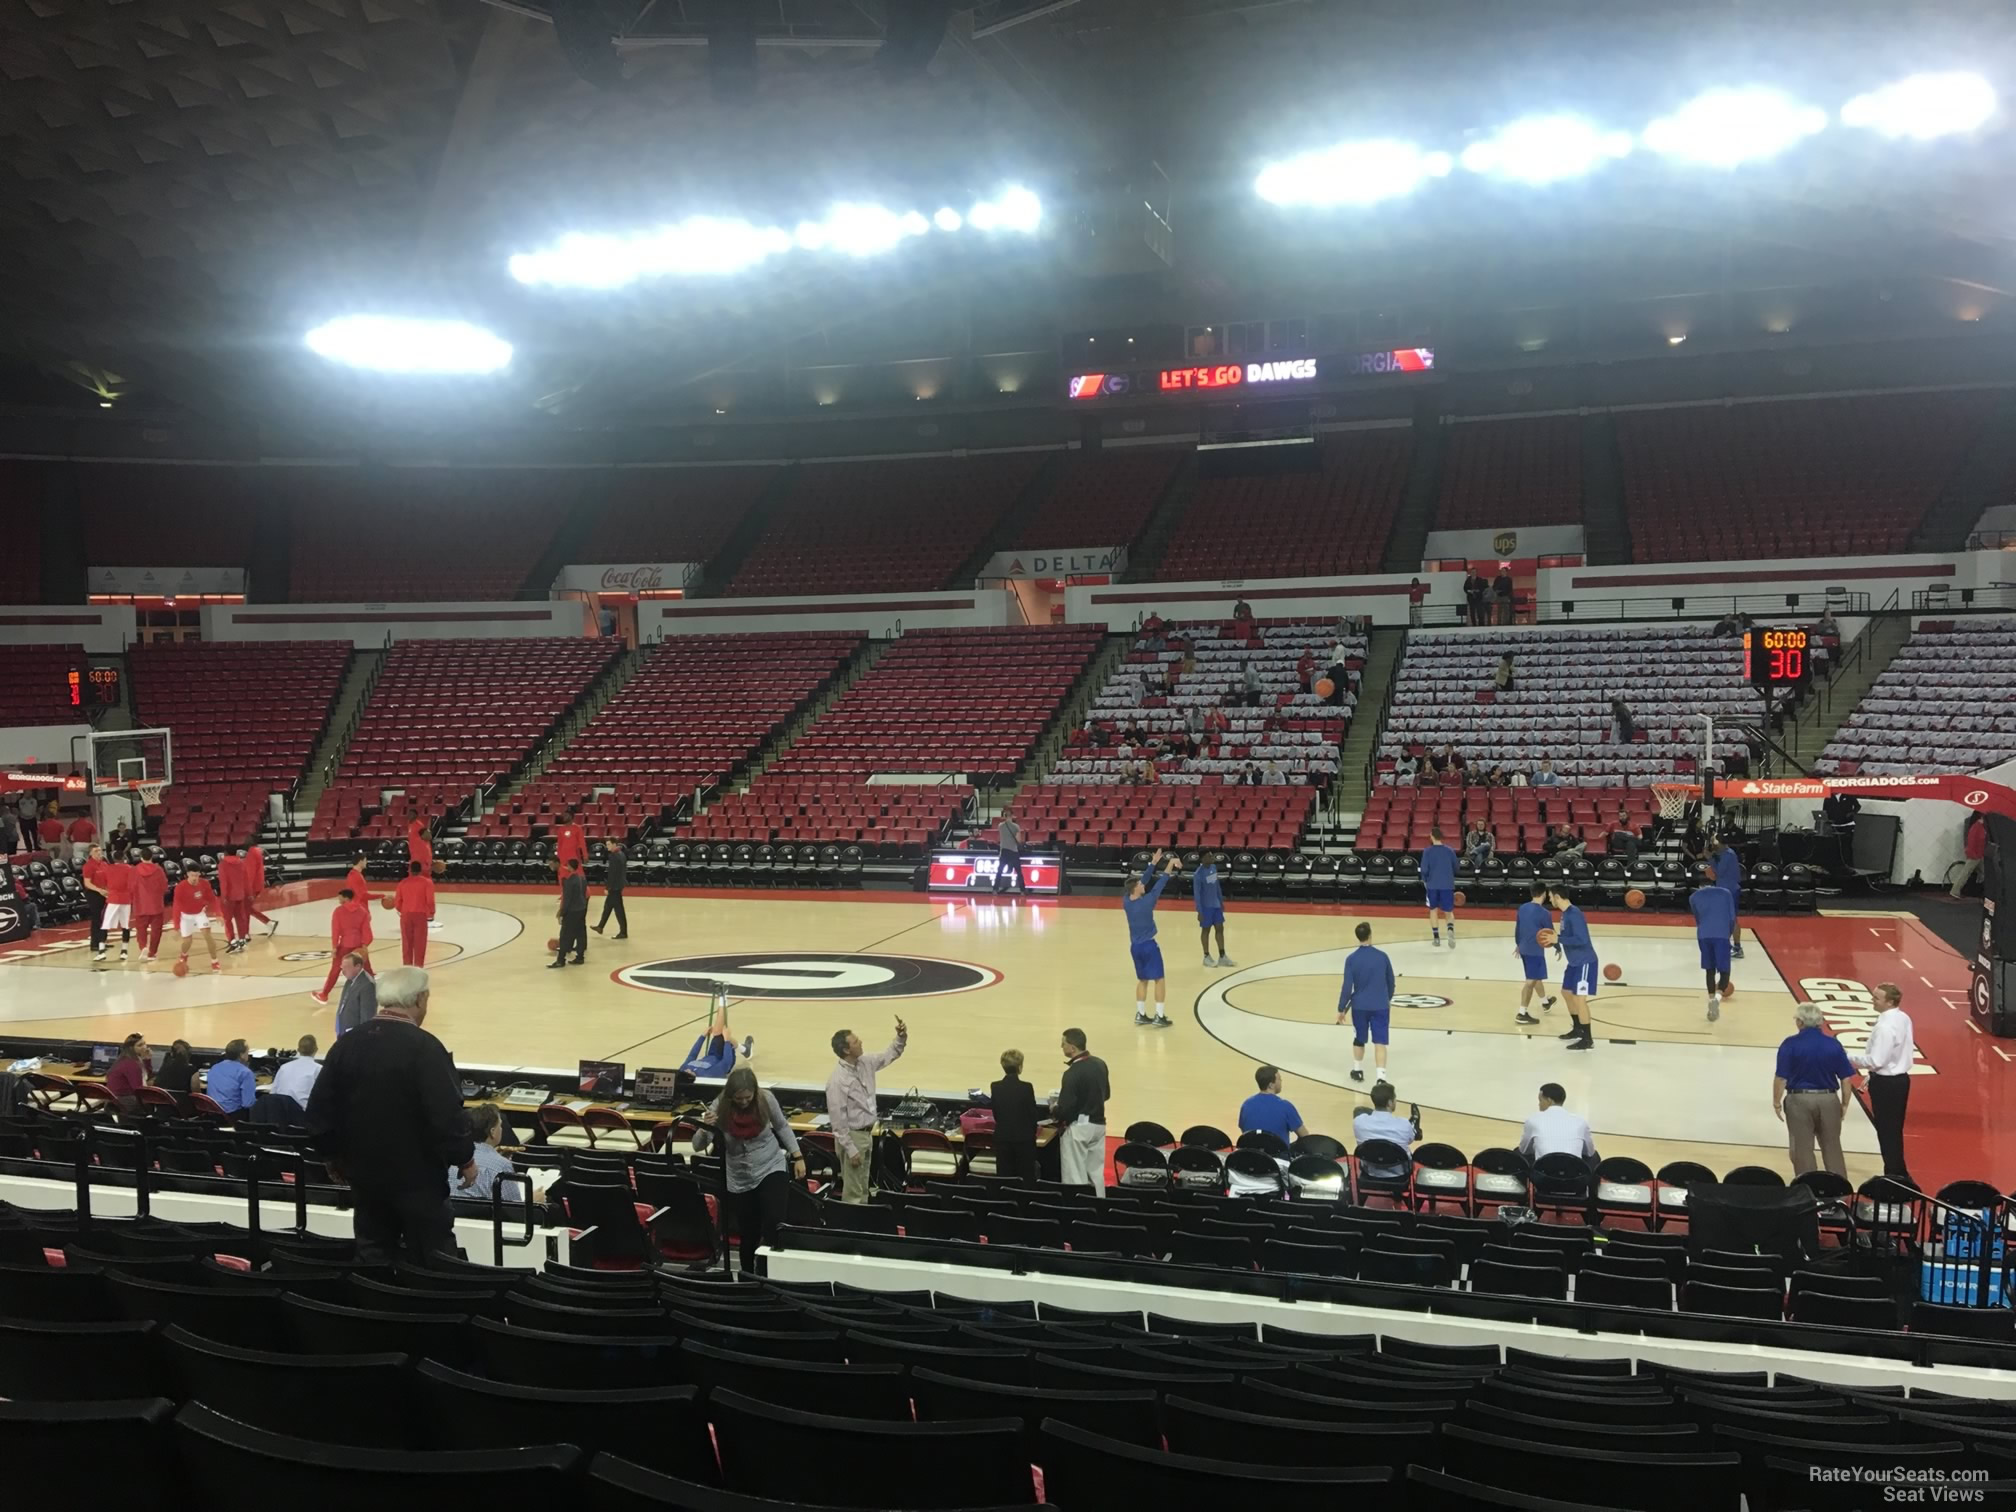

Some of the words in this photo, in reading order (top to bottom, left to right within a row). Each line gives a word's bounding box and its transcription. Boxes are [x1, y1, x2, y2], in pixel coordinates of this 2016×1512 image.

[1161, 368, 1209, 389] LET'S
[1215, 366, 1242, 385] GO
[1247, 359, 1317, 383] DAWGS
[1495, 538, 1515, 553] ups
[1034, 554, 1112, 573] DELTA
[1764, 632, 1806, 648] 60:00
[1770, 649, 1802, 678] 30
[89, 671, 117, 682] 60:00
